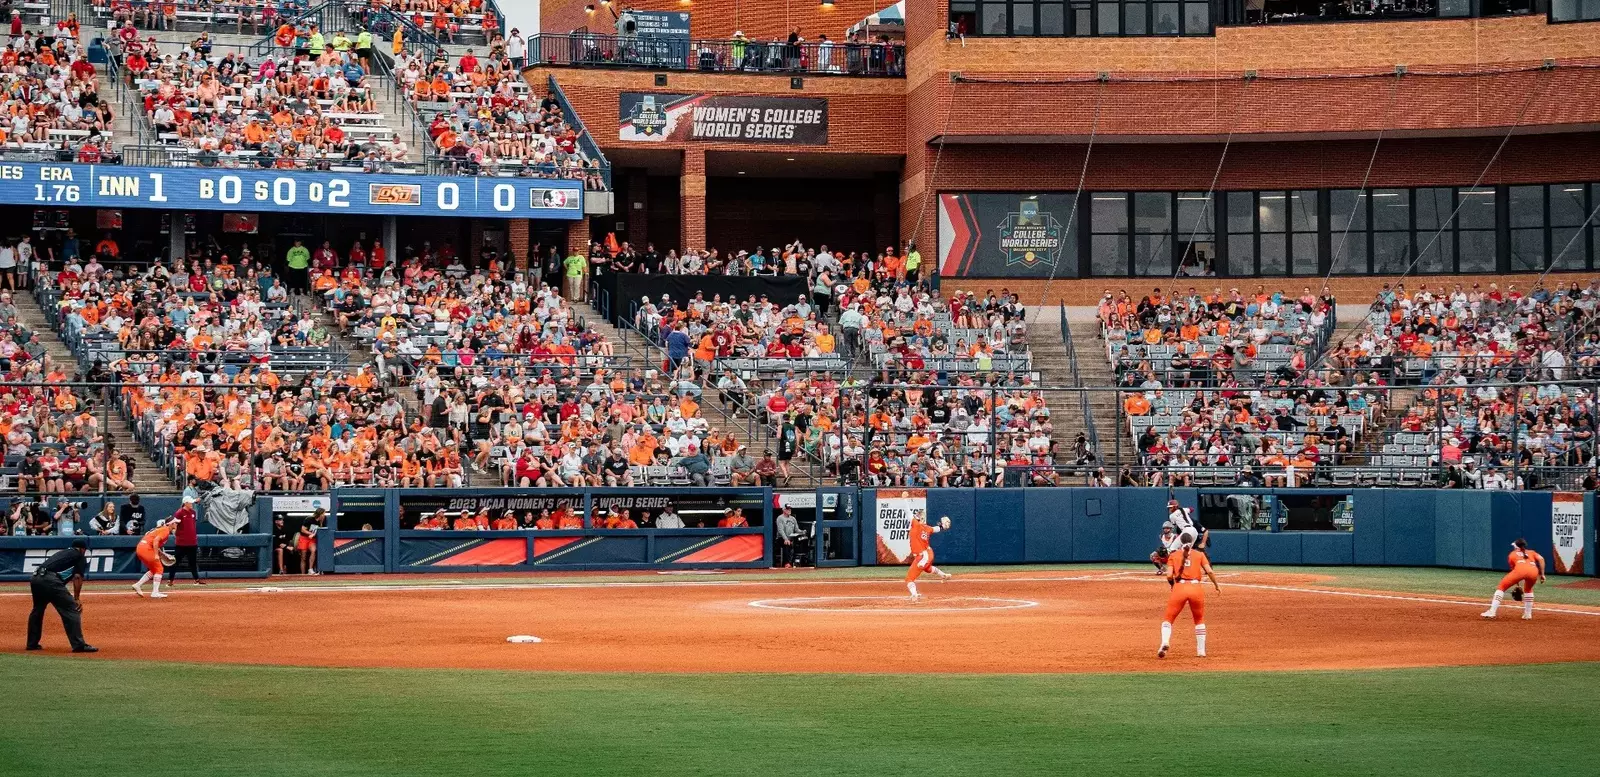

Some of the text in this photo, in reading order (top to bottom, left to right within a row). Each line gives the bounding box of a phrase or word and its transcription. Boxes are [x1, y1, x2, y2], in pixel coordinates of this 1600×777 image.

[693, 107, 822, 124] WOMEN'S COLLEGE
[693, 121, 795, 139] WORLD SERIES
[0, 165, 73, 181] ES ERA
[34, 184, 80, 201] 1.76
[98, 173, 168, 202] INN 1
[437, 182, 460, 210] 0
[493, 183, 516, 212] 0
[1013, 230, 1046, 238] COLLEGE
[1002, 238, 1058, 248] WORLD SERIES
[449, 498, 477, 510] 2023
[479, 498, 505, 510] NCAA
[507, 498, 555, 510] WOMEN'S
[635, 498, 670, 509] SERIES
[883, 519, 911, 530] SHOW
[1553, 513, 1582, 524] GREATEST
[1555, 525, 1573, 536] SHOW
[1560, 536, 1574, 547] DIRT
